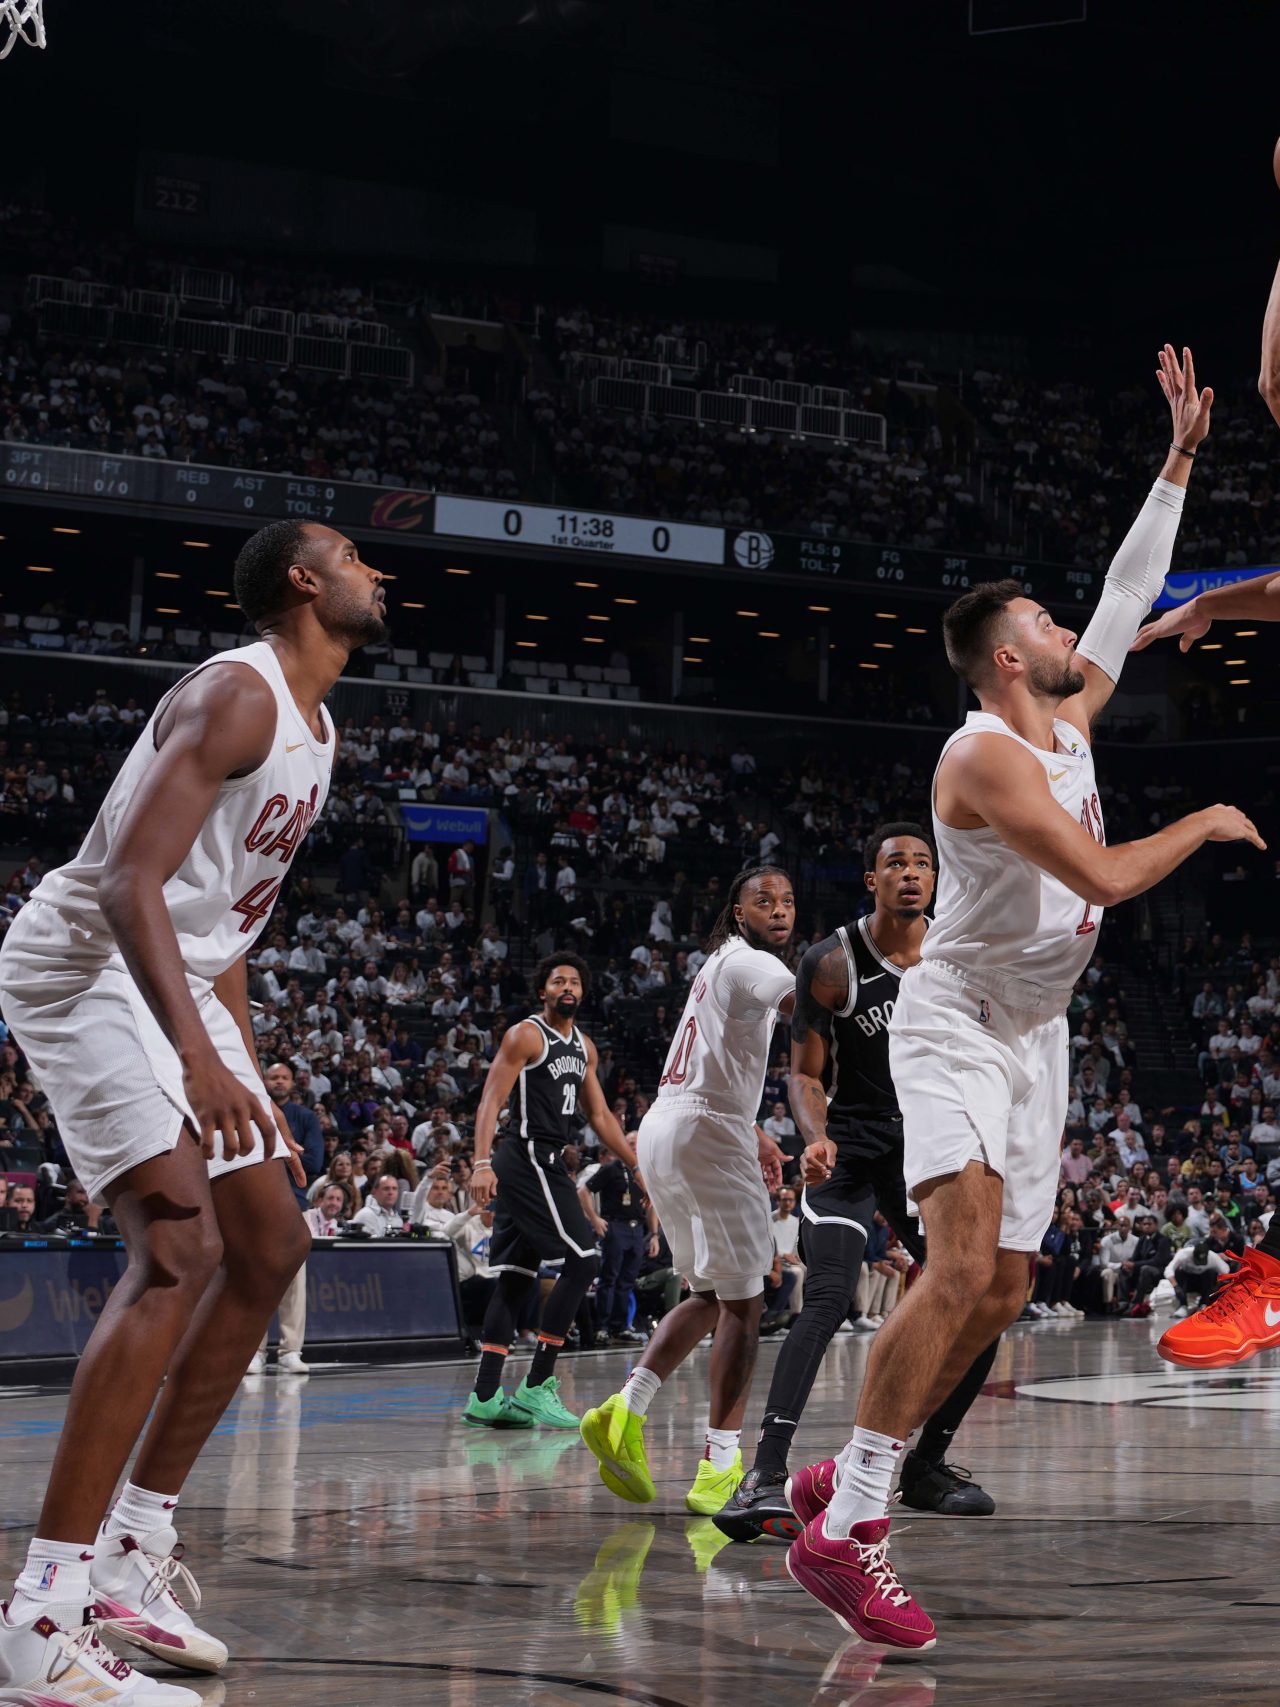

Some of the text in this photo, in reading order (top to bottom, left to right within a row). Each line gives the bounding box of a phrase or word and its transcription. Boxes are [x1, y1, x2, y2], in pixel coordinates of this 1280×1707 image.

[156, 190, 198, 212] 212
[10, 451, 43, 465] 3PT
[102, 461, 122, 474] FT
[176, 469, 210, 485] REB
[233, 476, 266, 491] AST
[186, 489, 197, 502] 0
[287, 482, 335, 500] FLS: 0
[244, 496, 255, 509] 0
[285, 499, 335, 518] TOL: 7
[504, 510, 522, 536] 0
[557, 514, 614, 538] 11:38
[551, 534, 615, 550] 1st Quarter
[652, 526, 670, 553] 0
[800, 541, 841, 558] FLS: 0
[881, 551, 900, 564] FG
[800, 557, 841, 574] TOL: 7
[944, 558, 968, 570] 3PT
[1011, 565, 1027, 577] FT
[1066, 571, 1091, 585] REB
[1075, 588, 1084, 600] 0
[436, 818, 482, 833] Webull
[231, 876, 282, 934] 4
[562, 1083, 576, 1115] 26
